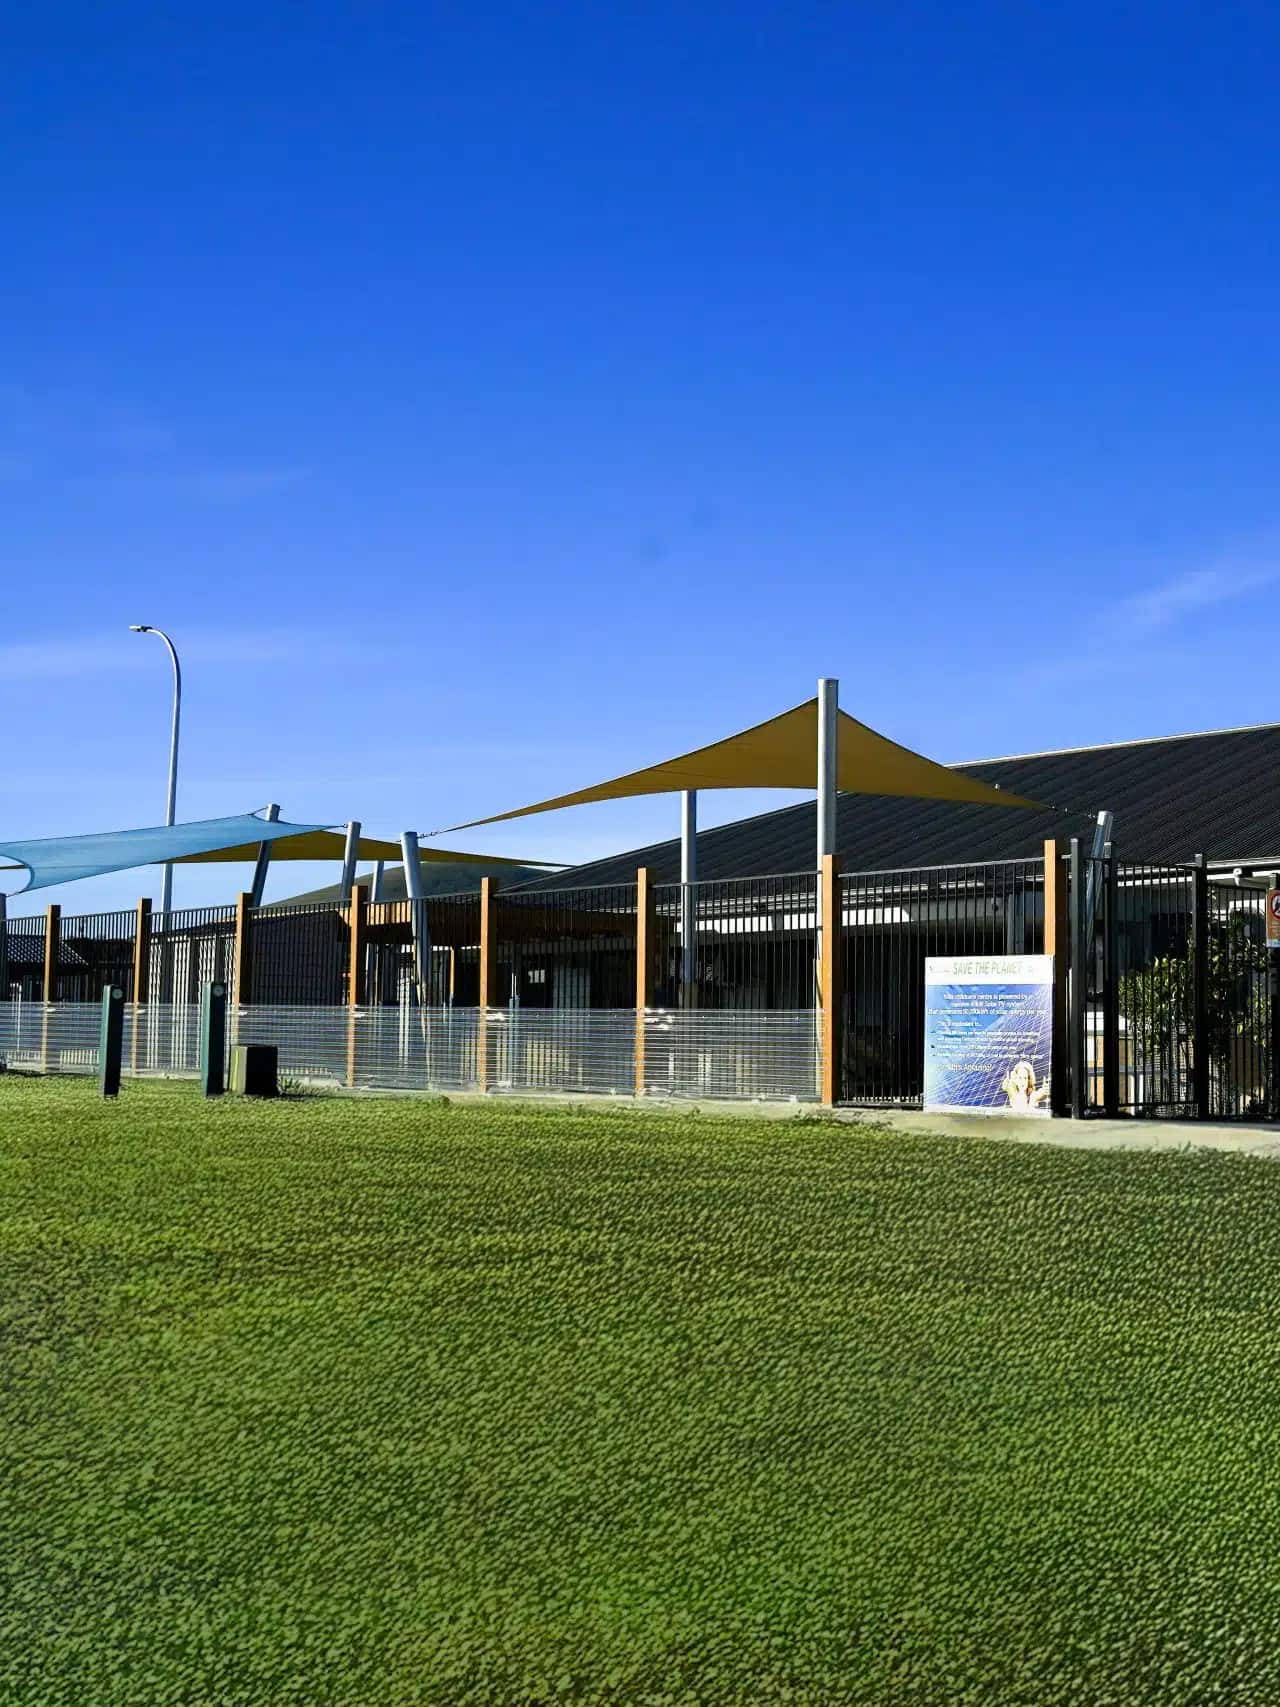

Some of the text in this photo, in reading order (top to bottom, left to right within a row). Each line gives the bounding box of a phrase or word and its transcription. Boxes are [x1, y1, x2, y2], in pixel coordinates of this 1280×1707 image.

[953, 961, 1023, 975] SAVE THE PLANET
